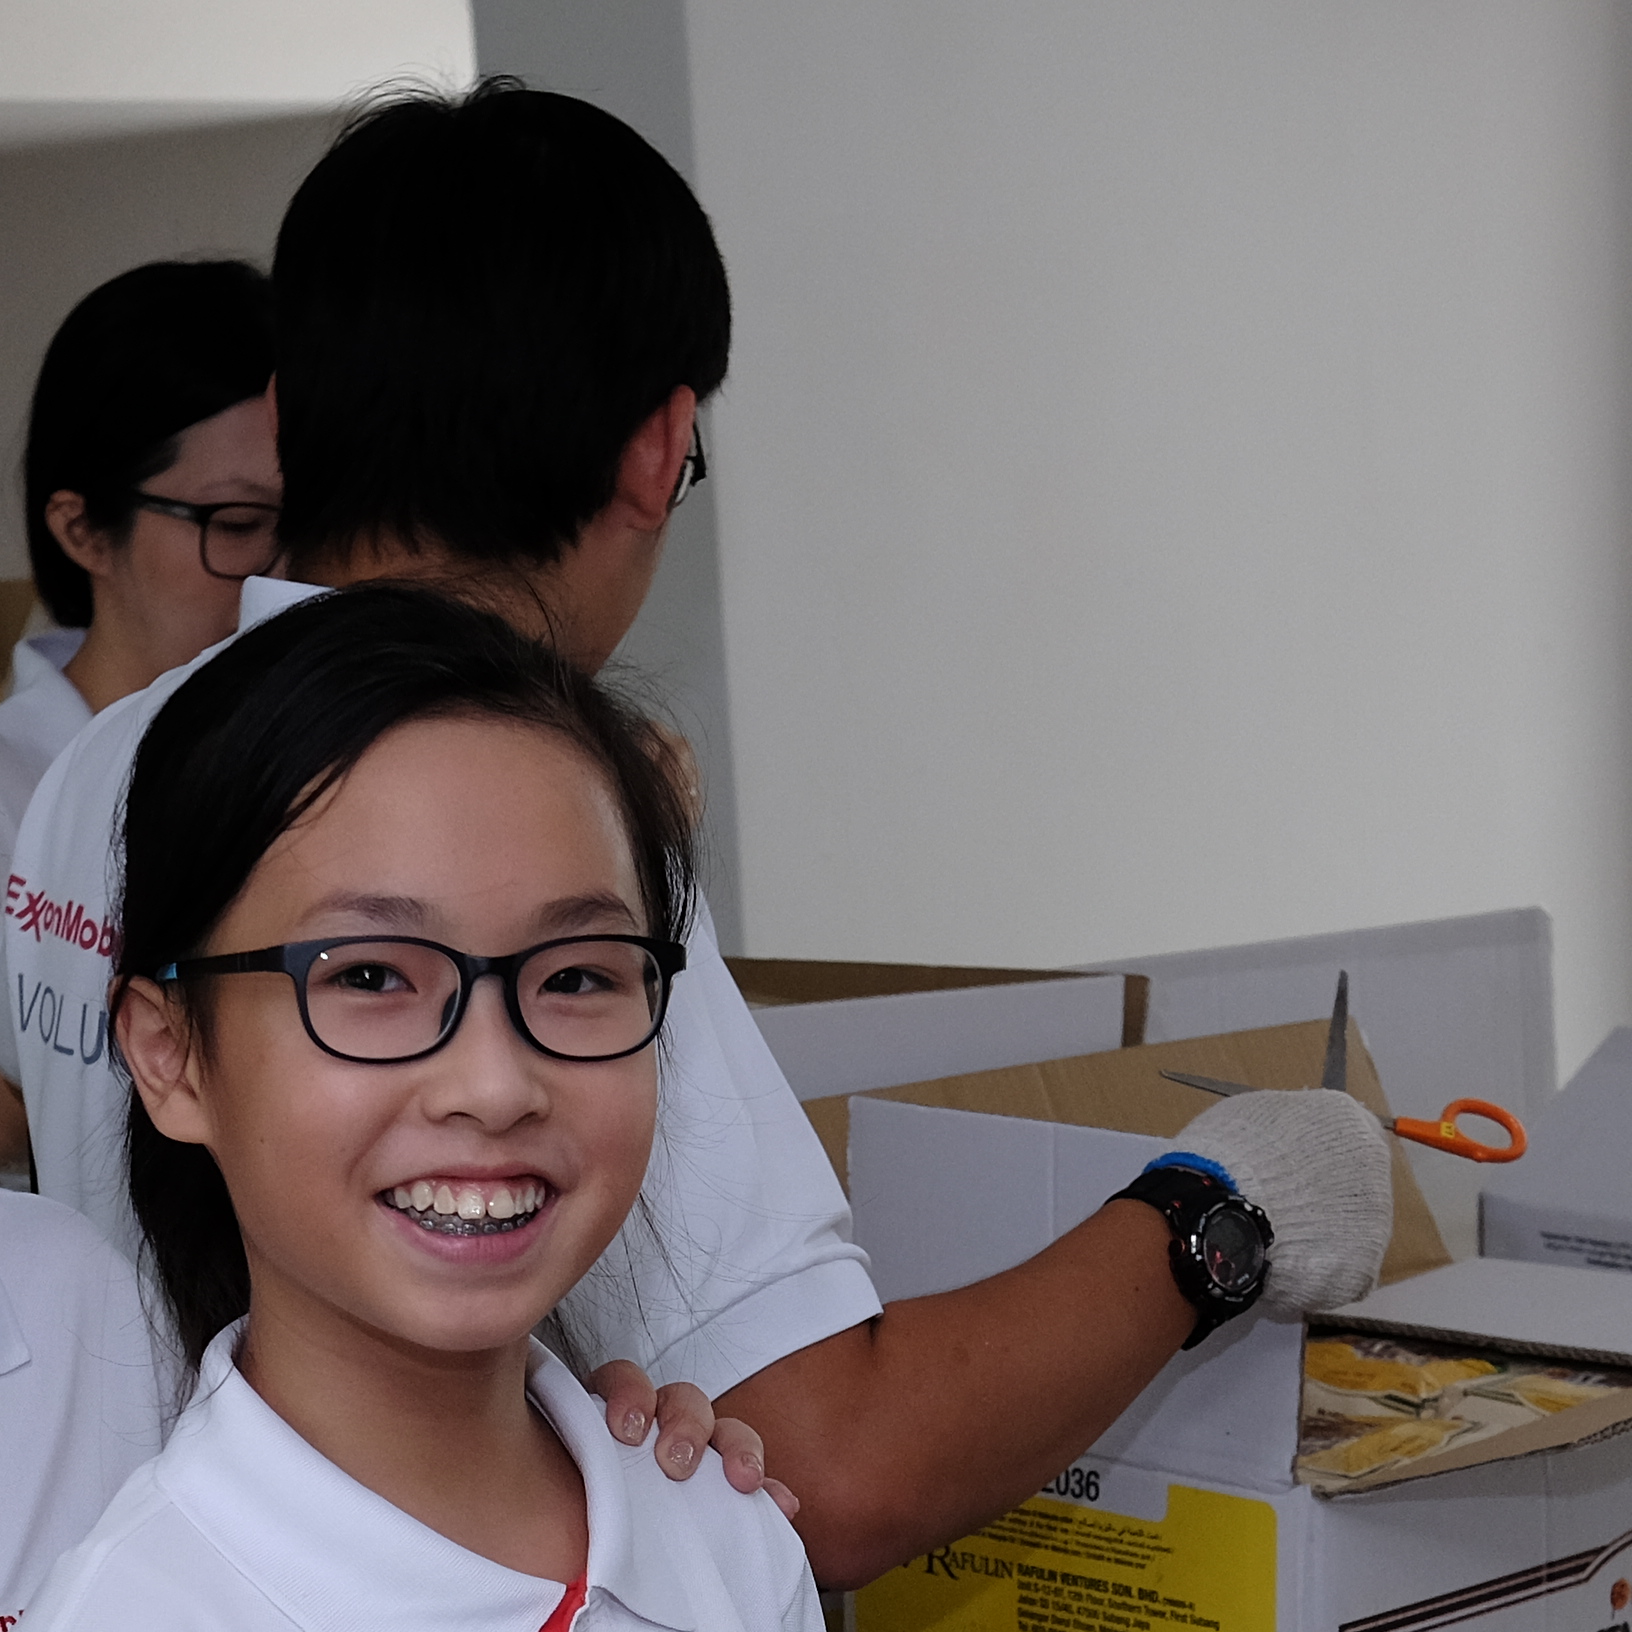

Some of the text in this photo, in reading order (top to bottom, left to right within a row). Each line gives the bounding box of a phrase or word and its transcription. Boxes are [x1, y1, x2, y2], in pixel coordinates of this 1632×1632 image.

[5, 873, 121, 958] ExxonMob
[17, 973, 108, 1065] VOLU
[1041, 1467, 1100, 1502] 036
